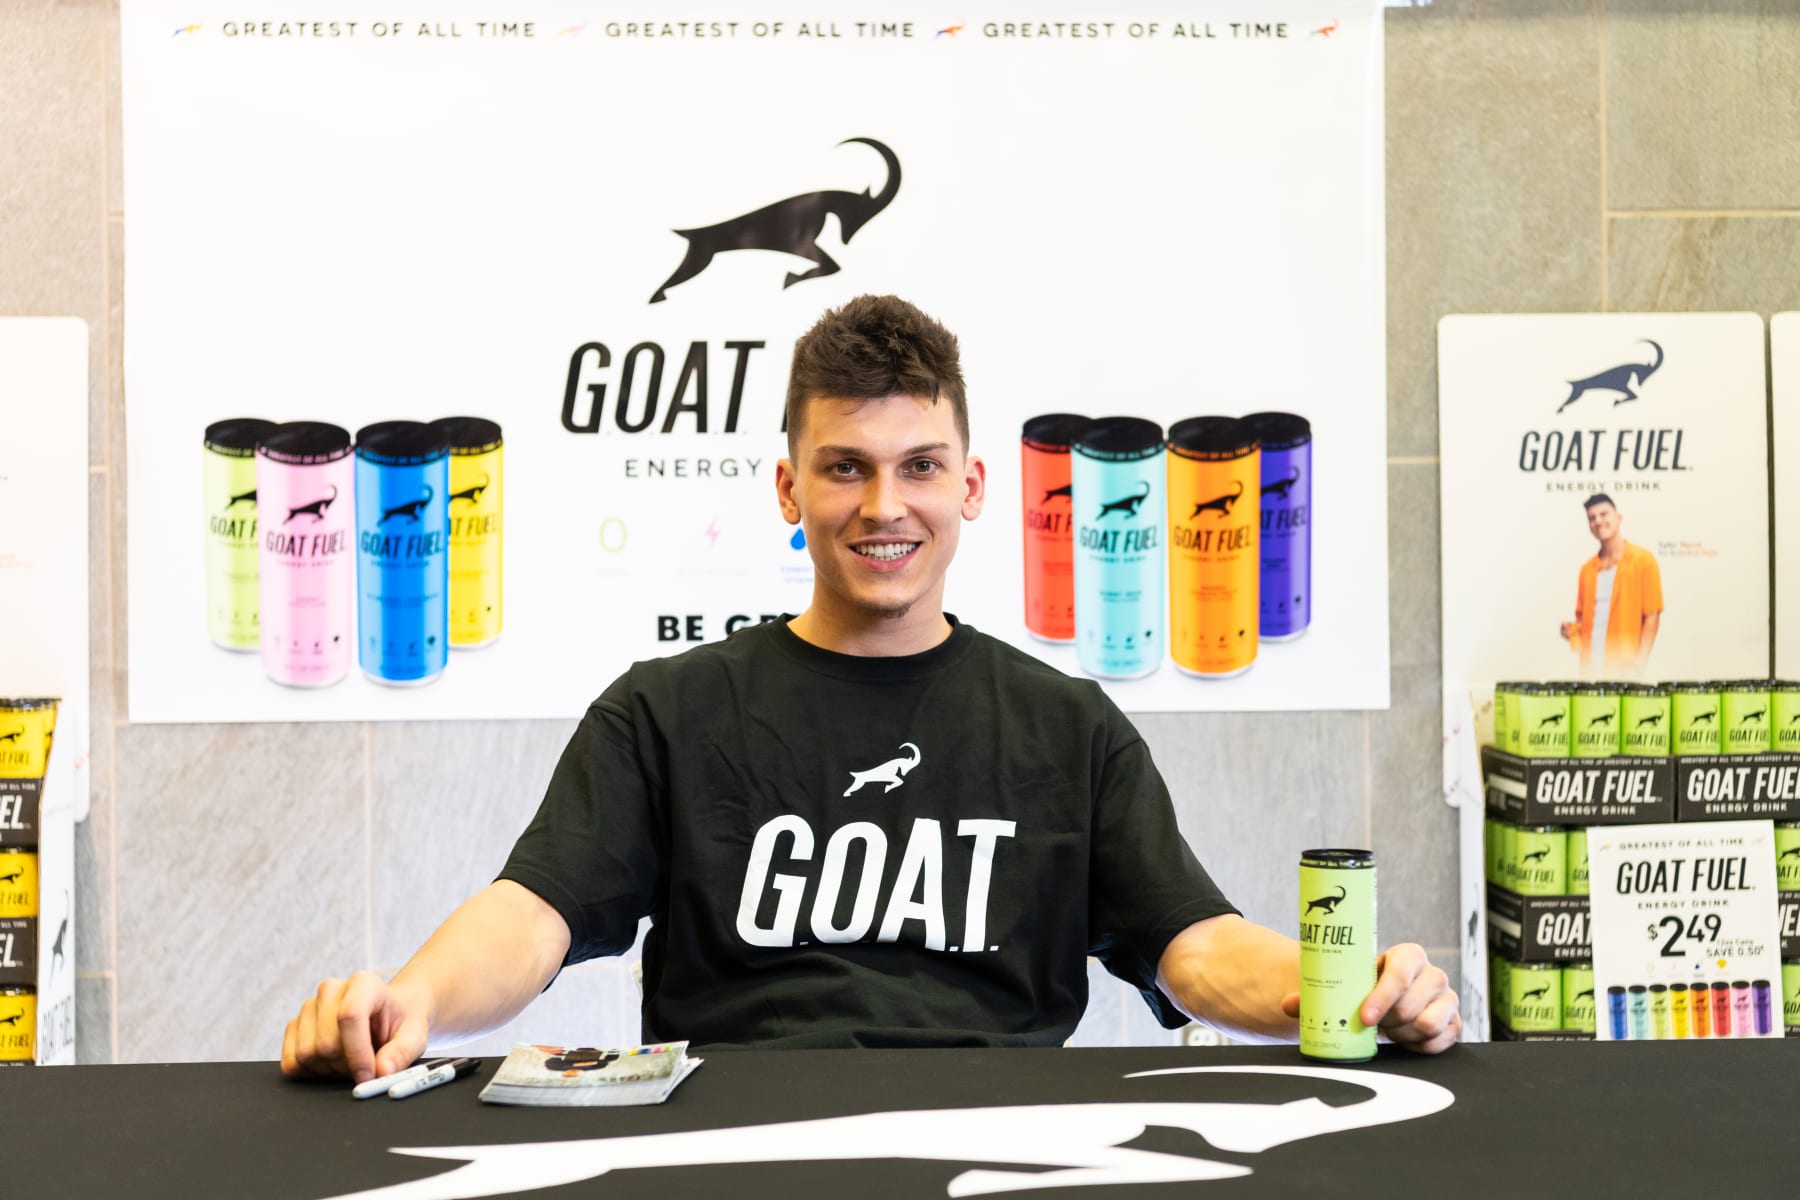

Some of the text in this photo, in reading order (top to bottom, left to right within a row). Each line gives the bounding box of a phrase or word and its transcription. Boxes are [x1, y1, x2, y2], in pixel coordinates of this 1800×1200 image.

[222, 21, 536, 38] GREATEST OF ALL TIME
[604, 21, 915, 38] GREATEST OF ALL TIME
[982, 21, 1288, 38] GREATEST OF ALL TIME
[1518, 429, 1607, 472] GOAT
[625, 458, 762, 478] ENERGY
[1545, 481, 1662, 493] ENERGY DRINK
[266, 529, 307, 558] GOAT
[360, 530, 403, 559] GOAT
[1079, 525, 1120, 554] GOAT
[657, 614, 705, 642] BE
[1535, 769, 1601, 804] GOAT
[1601, 769, 1657, 804] FUEL
[1686, 767, 1752, 802] GOAT
[1553, 805, 1637, 816] ENERGY DRINK
[1704, 802, 1788, 814] ENERGY DRINK
[1615, 858, 1686, 895] GOAT
[1637, 899, 1729, 910] ENERGY DRINK
[1322, 925, 1355, 946] FUEL
[1706, 946, 1734, 958] SAVE
